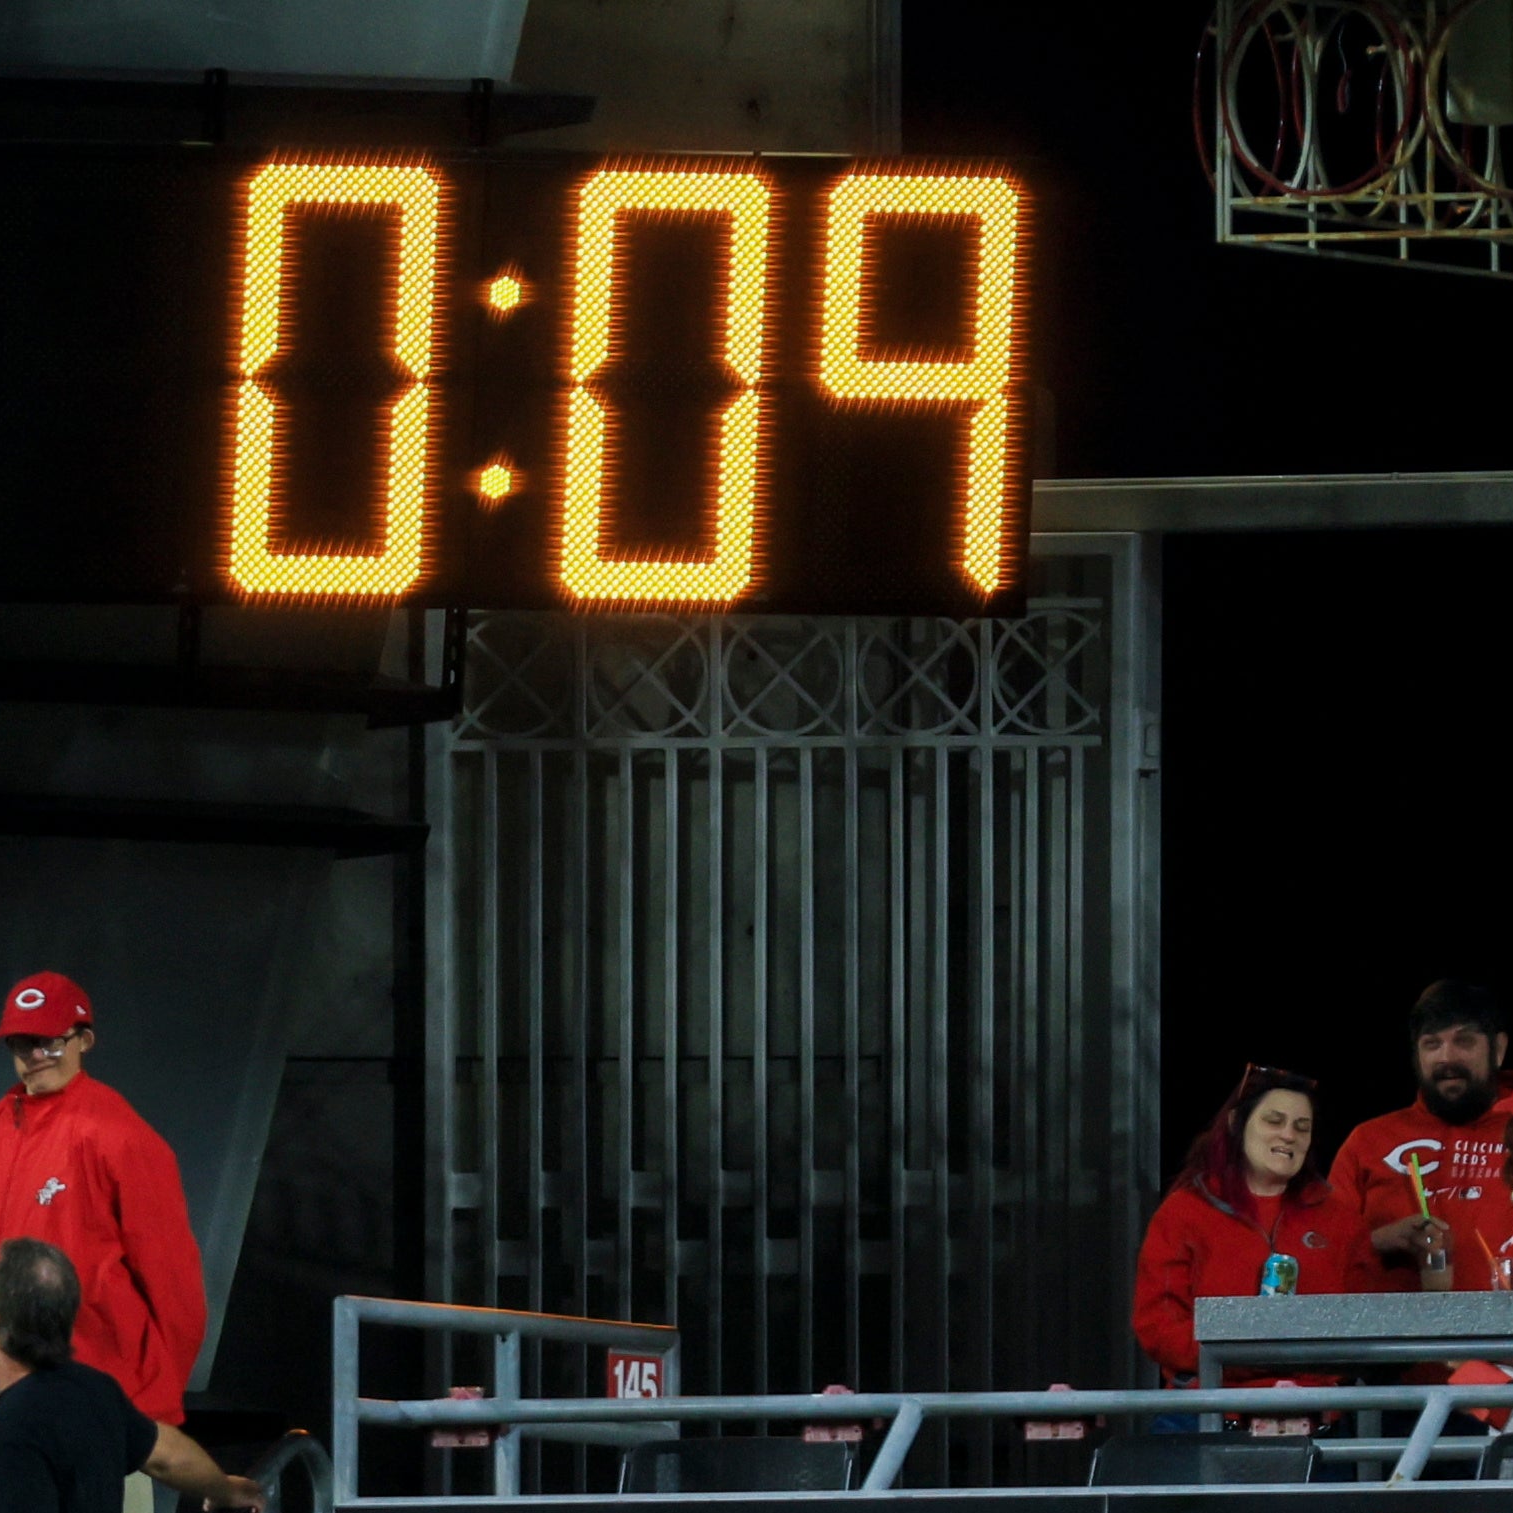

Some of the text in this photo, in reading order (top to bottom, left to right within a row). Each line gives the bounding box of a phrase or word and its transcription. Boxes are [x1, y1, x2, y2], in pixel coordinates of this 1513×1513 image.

[229, 162, 1019, 601] 0:09
[1452, 1152, 1488, 1166] REDS
[614, 1359, 658, 1399] 145
